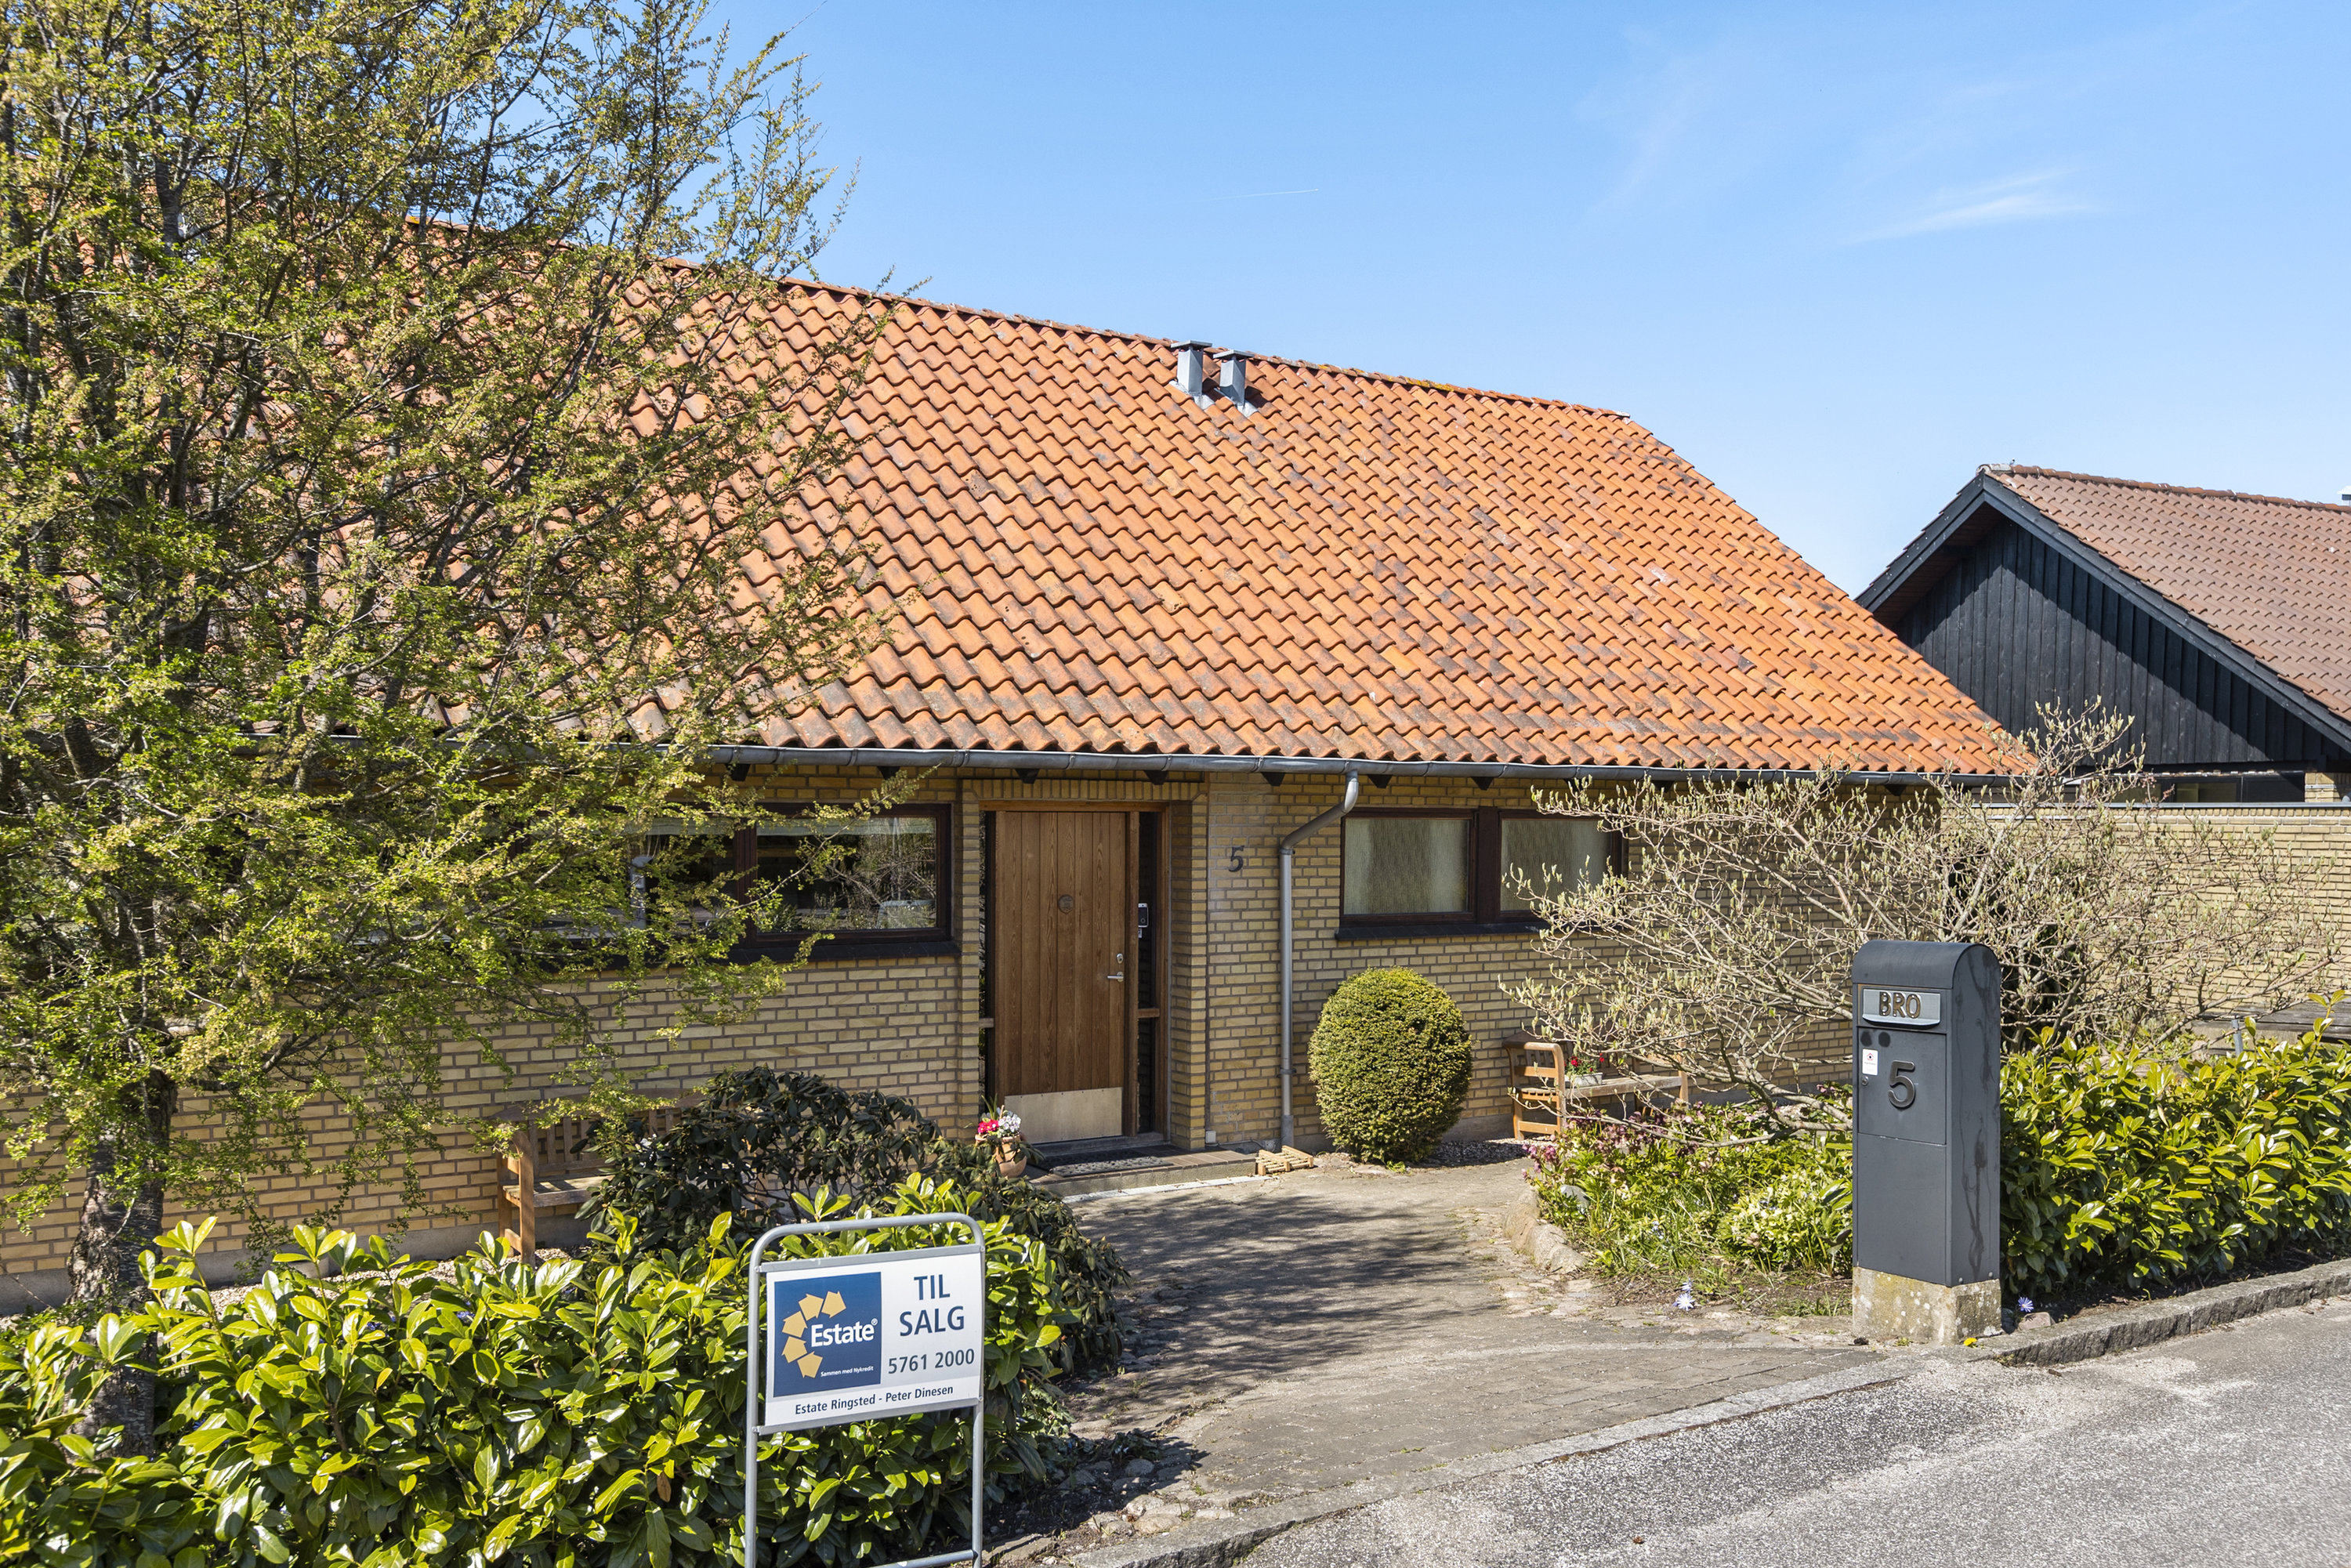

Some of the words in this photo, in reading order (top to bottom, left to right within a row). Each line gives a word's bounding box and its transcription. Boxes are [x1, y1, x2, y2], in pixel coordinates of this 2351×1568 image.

[1228, 845, 1245, 872] 5
[1879, 991, 1922, 1019] BRO
[1888, 1060, 1915, 1108] 5
[914, 1274, 951, 1300] TIL
[899, 1305, 965, 1337] SALG
[888, 1354, 927, 1374] 5761
[934, 1349, 975, 1368] 2000
[795, 1403, 828, 1415] Estate
[831, 1394, 876, 1410] Ringsted
[886, 1391, 912, 1403] Peter
[915, 1386, 954, 1399] Dinesen
